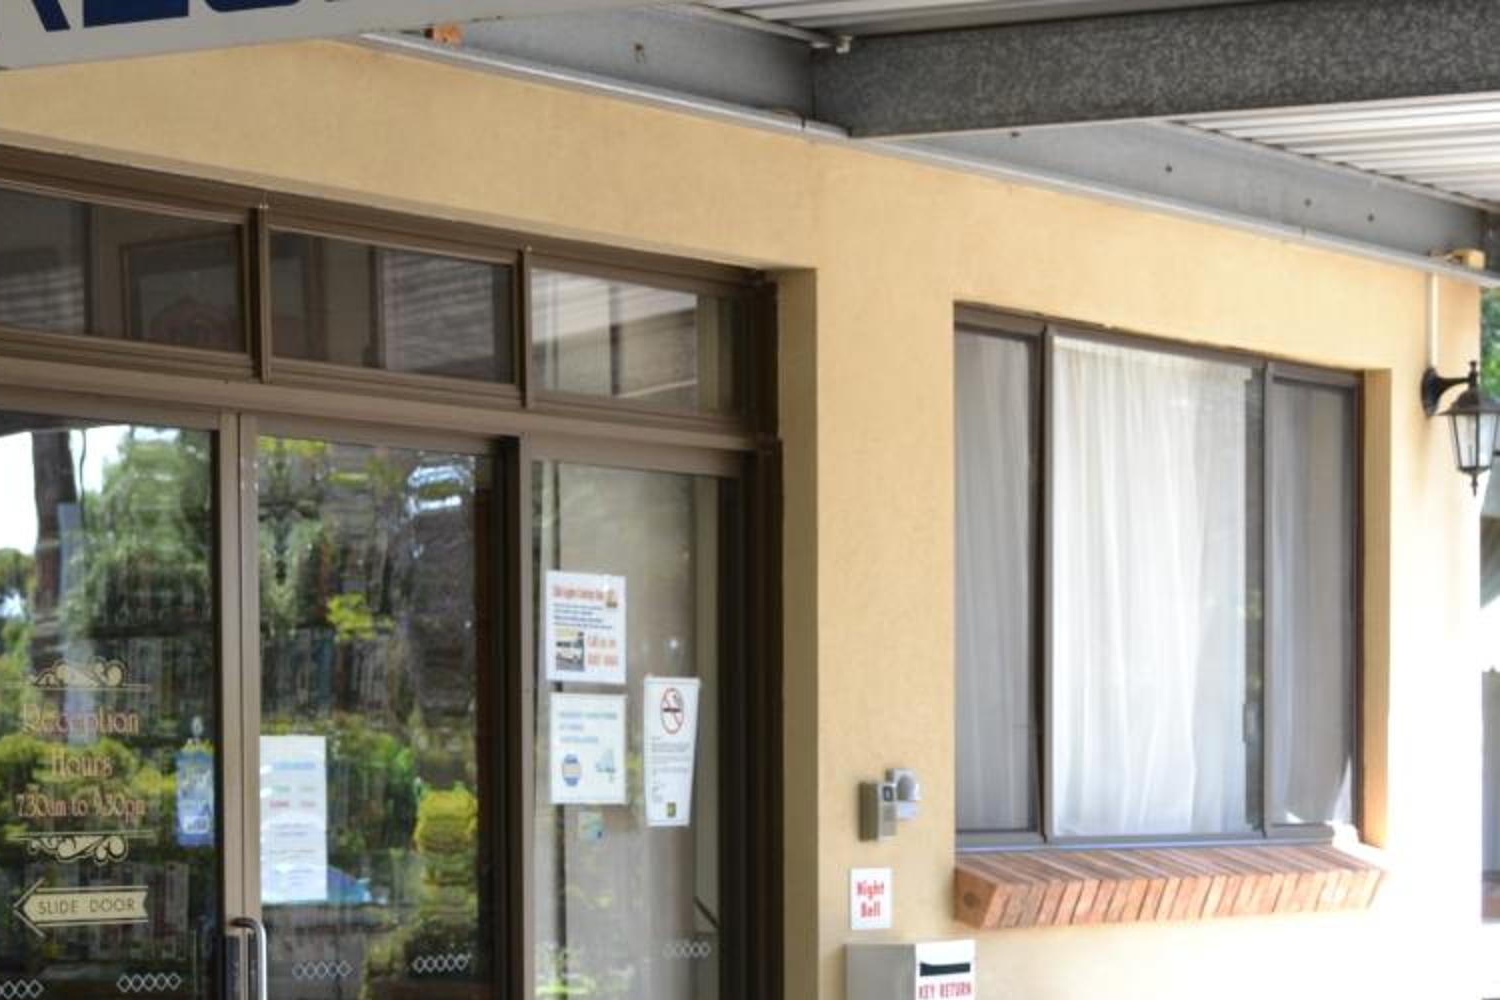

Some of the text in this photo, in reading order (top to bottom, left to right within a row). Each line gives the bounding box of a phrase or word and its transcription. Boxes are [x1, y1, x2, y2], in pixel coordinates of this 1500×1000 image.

[50, 747, 114, 778] Hours
[71, 797, 88, 817] to
[856, 879, 885, 901] Night
[37, 896, 136, 915] SLIDE DOOR
[860, 901, 881, 919] Bell
[918, 980, 972, 1000] KEY RETURN
